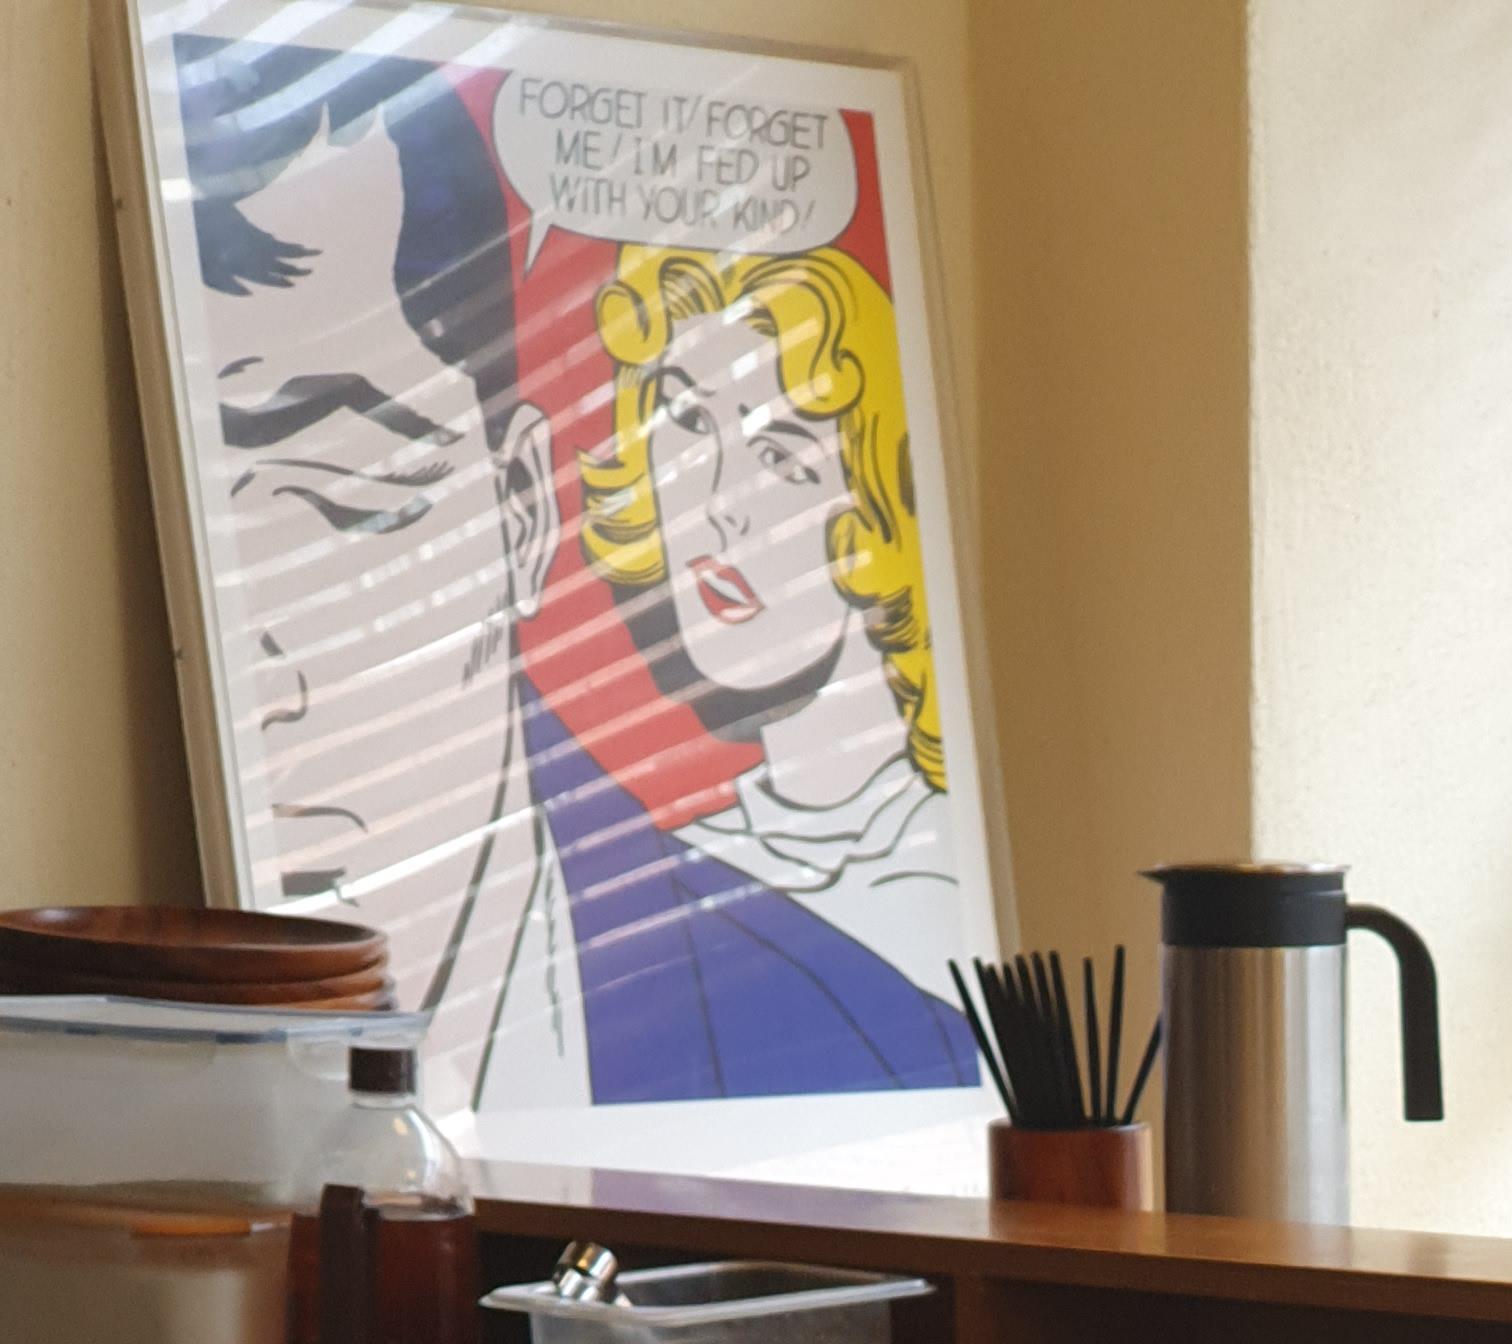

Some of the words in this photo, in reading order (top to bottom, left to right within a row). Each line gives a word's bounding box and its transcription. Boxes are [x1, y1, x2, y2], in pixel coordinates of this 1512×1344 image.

[519, 78, 648, 129] FORGET
[705, 101, 829, 149] FORGET
[697, 145, 760, 185] FED
[771, 154, 811, 192] UP
[549, 172, 627, 215] WITH
[636, 182, 719, 230] YOUR
